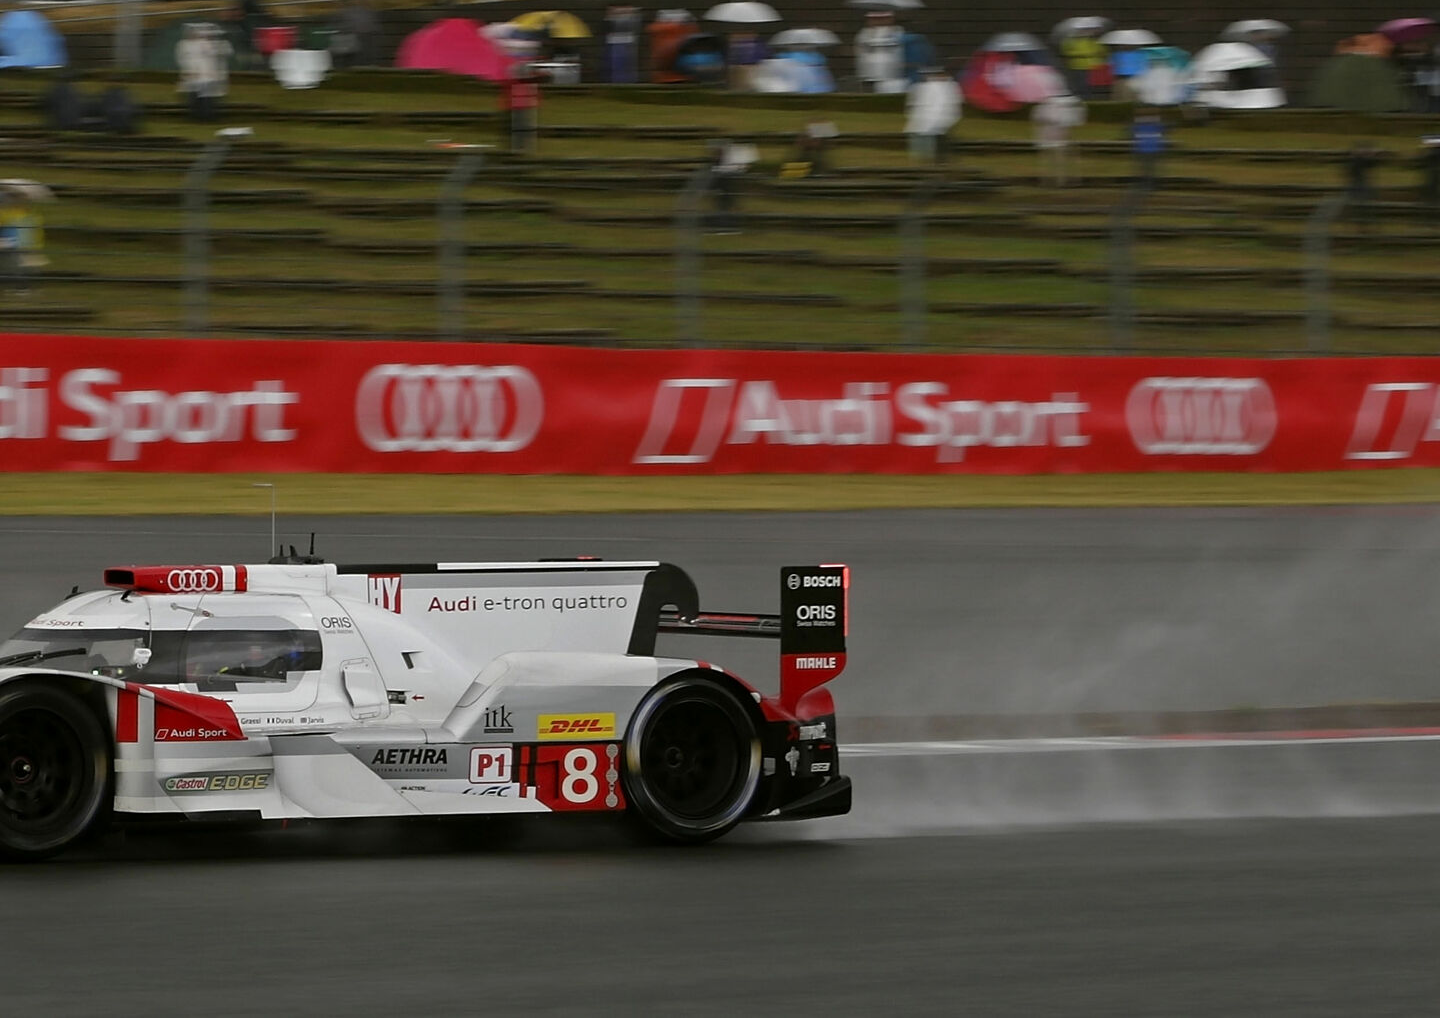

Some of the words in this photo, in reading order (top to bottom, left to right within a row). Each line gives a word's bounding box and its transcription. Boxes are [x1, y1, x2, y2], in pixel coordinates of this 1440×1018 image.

[57, 368, 298, 462] Sport
[728, 380, 889, 445] Audi
[895, 381, 1090, 463] Sport
[803, 576, 841, 588] BOSCH
[369, 577, 400, 612] HY
[428, 596, 477, 612] Audi
[483, 597, 545, 611] e-tron
[552, 595, 628, 613] quattro
[796, 605, 836, 620] ORIS
[47, 619, 85, 627] Sport
[321, 617, 352, 628] ORIS
[796, 657, 836, 669] MAHLE
[484, 704, 513, 728] itk
[170, 728, 195, 737] Audi
[198, 728, 228, 739] Sport
[549, 719, 604, 734] DHL
[371, 748, 448, 764] AETHRA
[477, 754, 506, 778] P1
[176, 778, 208, 789] Castrol
[209, 774, 269, 791] EDGE
[561, 747, 600, 804] 8
